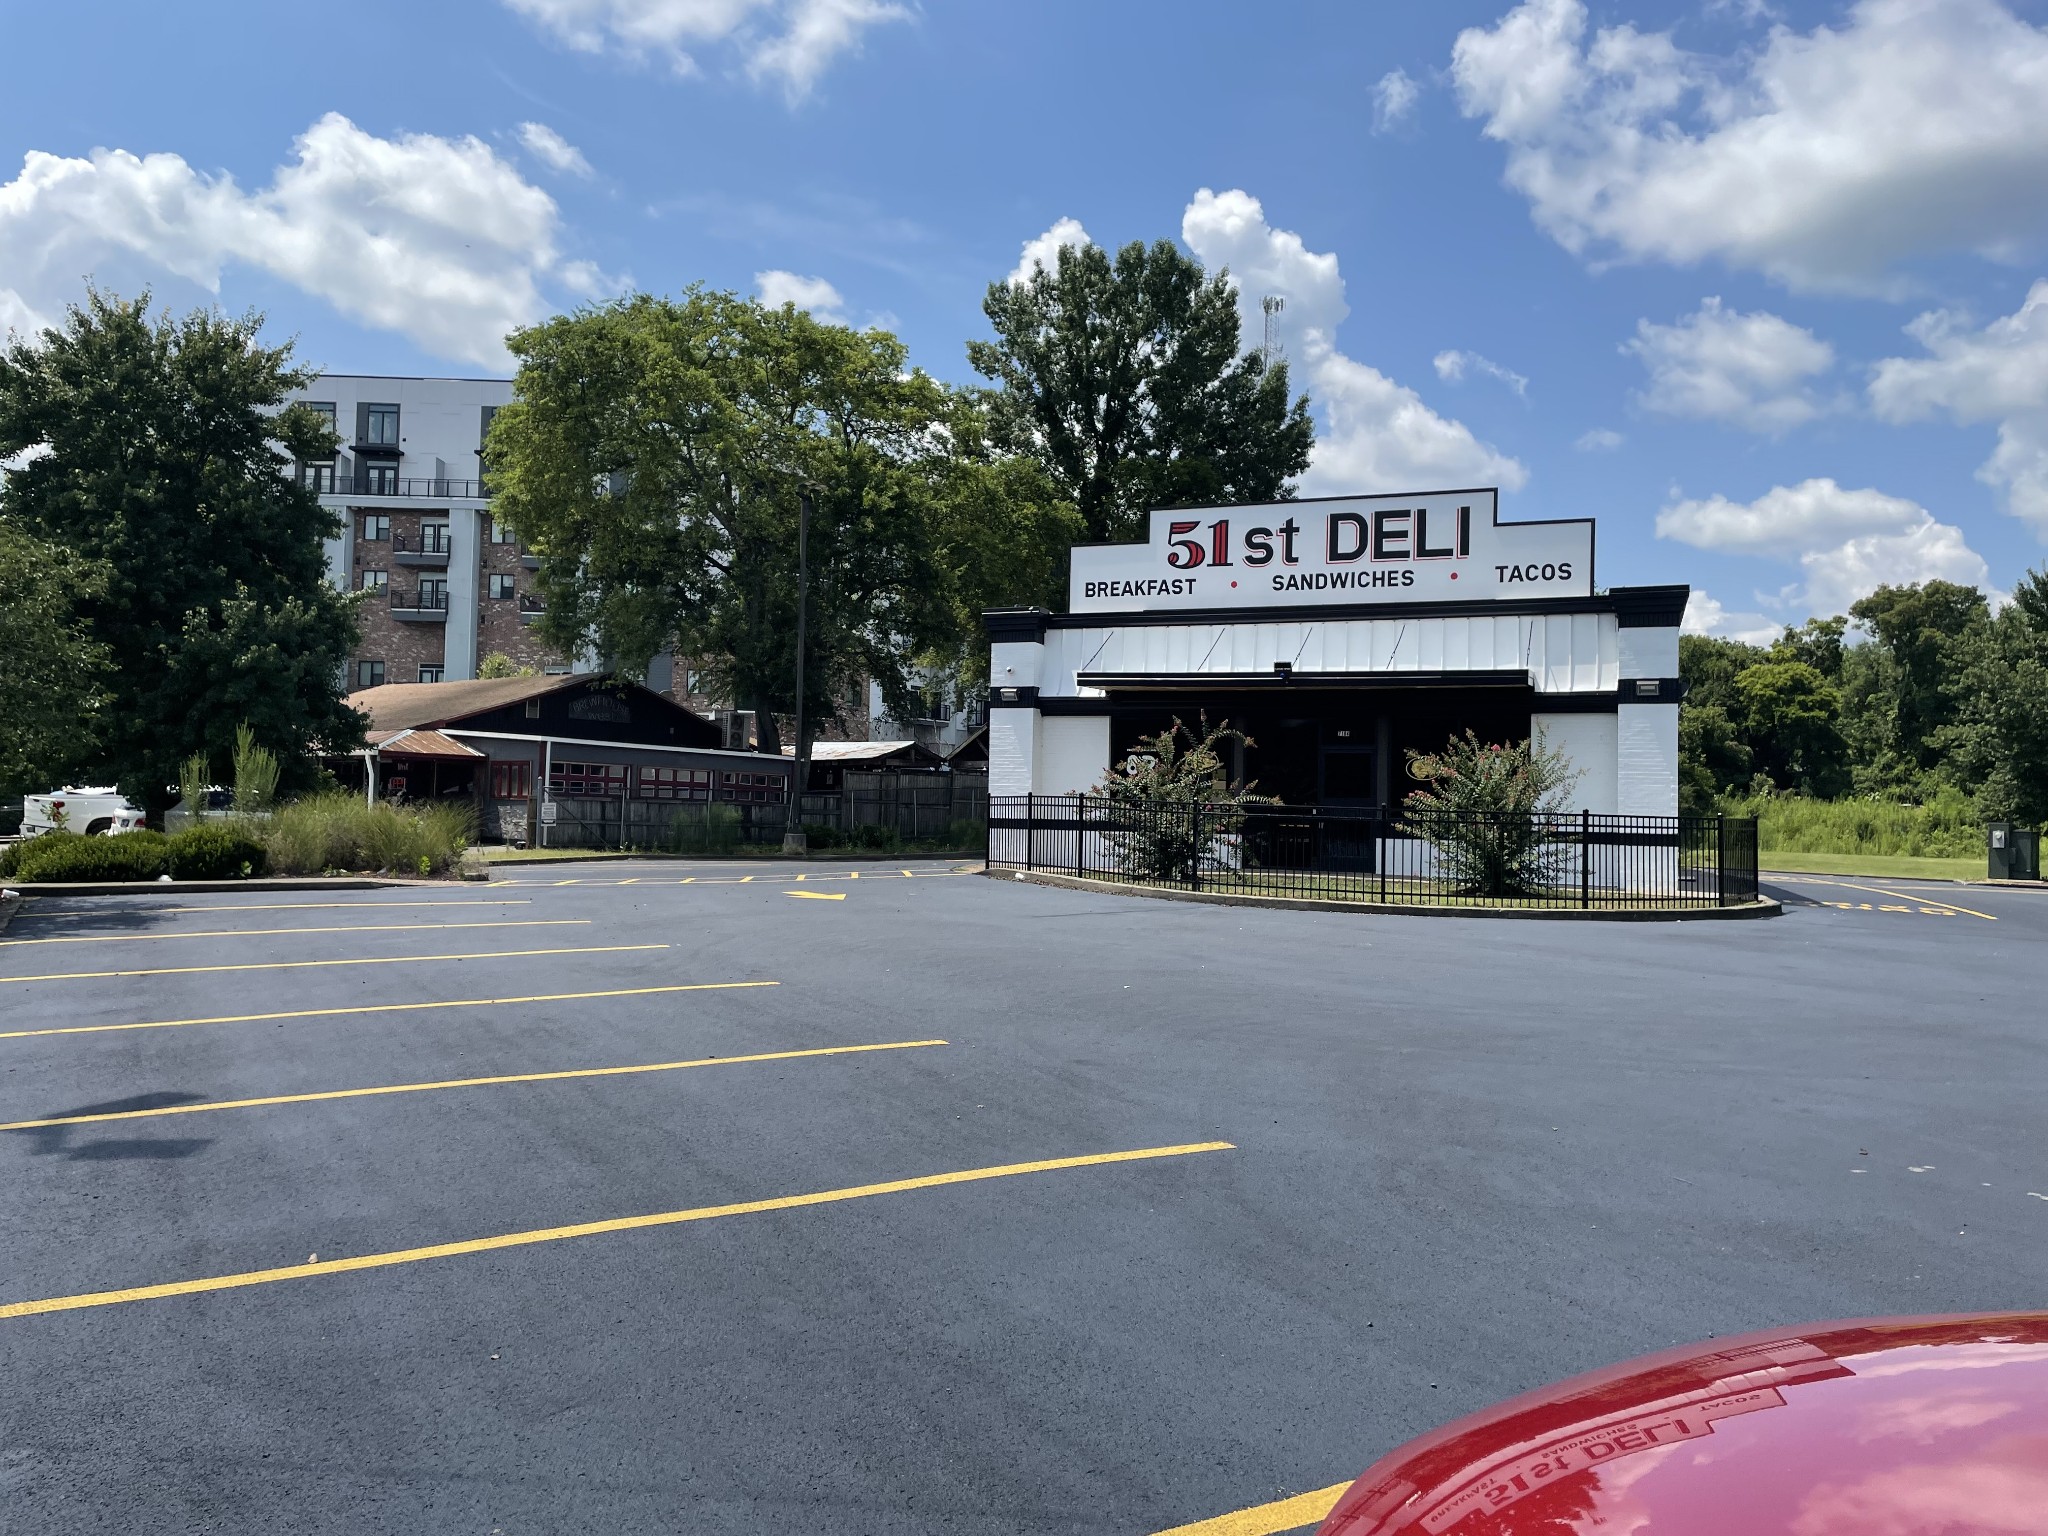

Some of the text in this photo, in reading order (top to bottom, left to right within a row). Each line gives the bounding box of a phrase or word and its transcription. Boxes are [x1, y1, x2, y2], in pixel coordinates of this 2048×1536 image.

[1167, 506, 1471, 569] 51st DELI
[1084, 562, 1573, 598] BREAKFAST SANDWICHES TACOS
